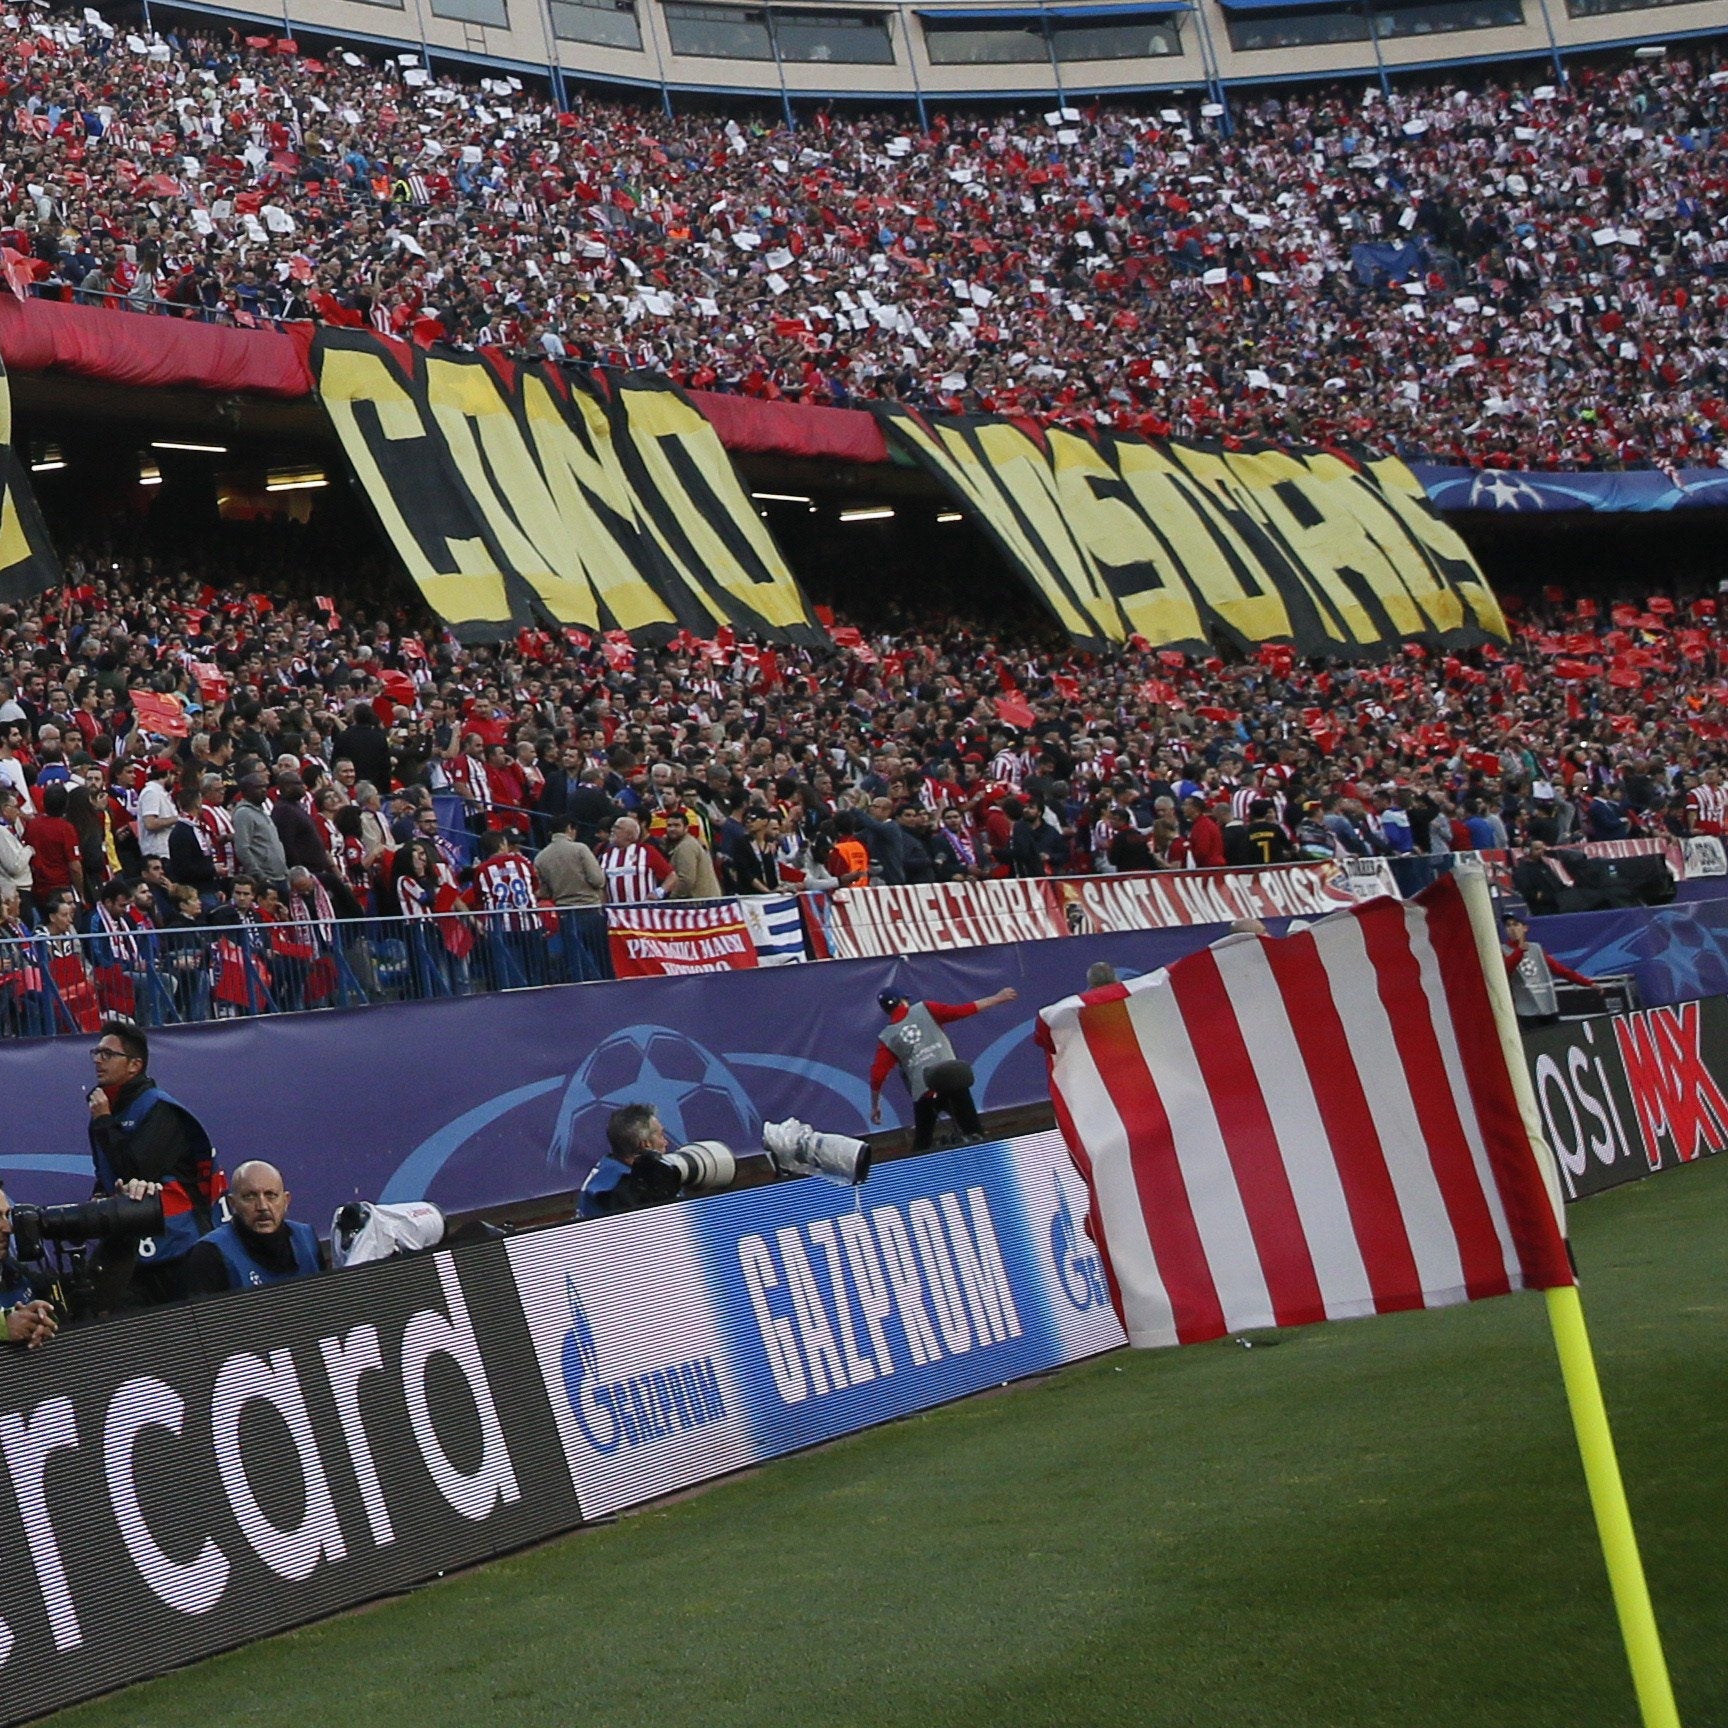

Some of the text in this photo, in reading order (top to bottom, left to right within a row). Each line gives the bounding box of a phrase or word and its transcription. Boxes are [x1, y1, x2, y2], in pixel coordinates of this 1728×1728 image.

[320, 348, 812, 631] COMO
[493, 878, 529, 910] 28
[1610, 1000, 1728, 1172] MAX
[736, 1186, 1024, 1404] GAZPROM
